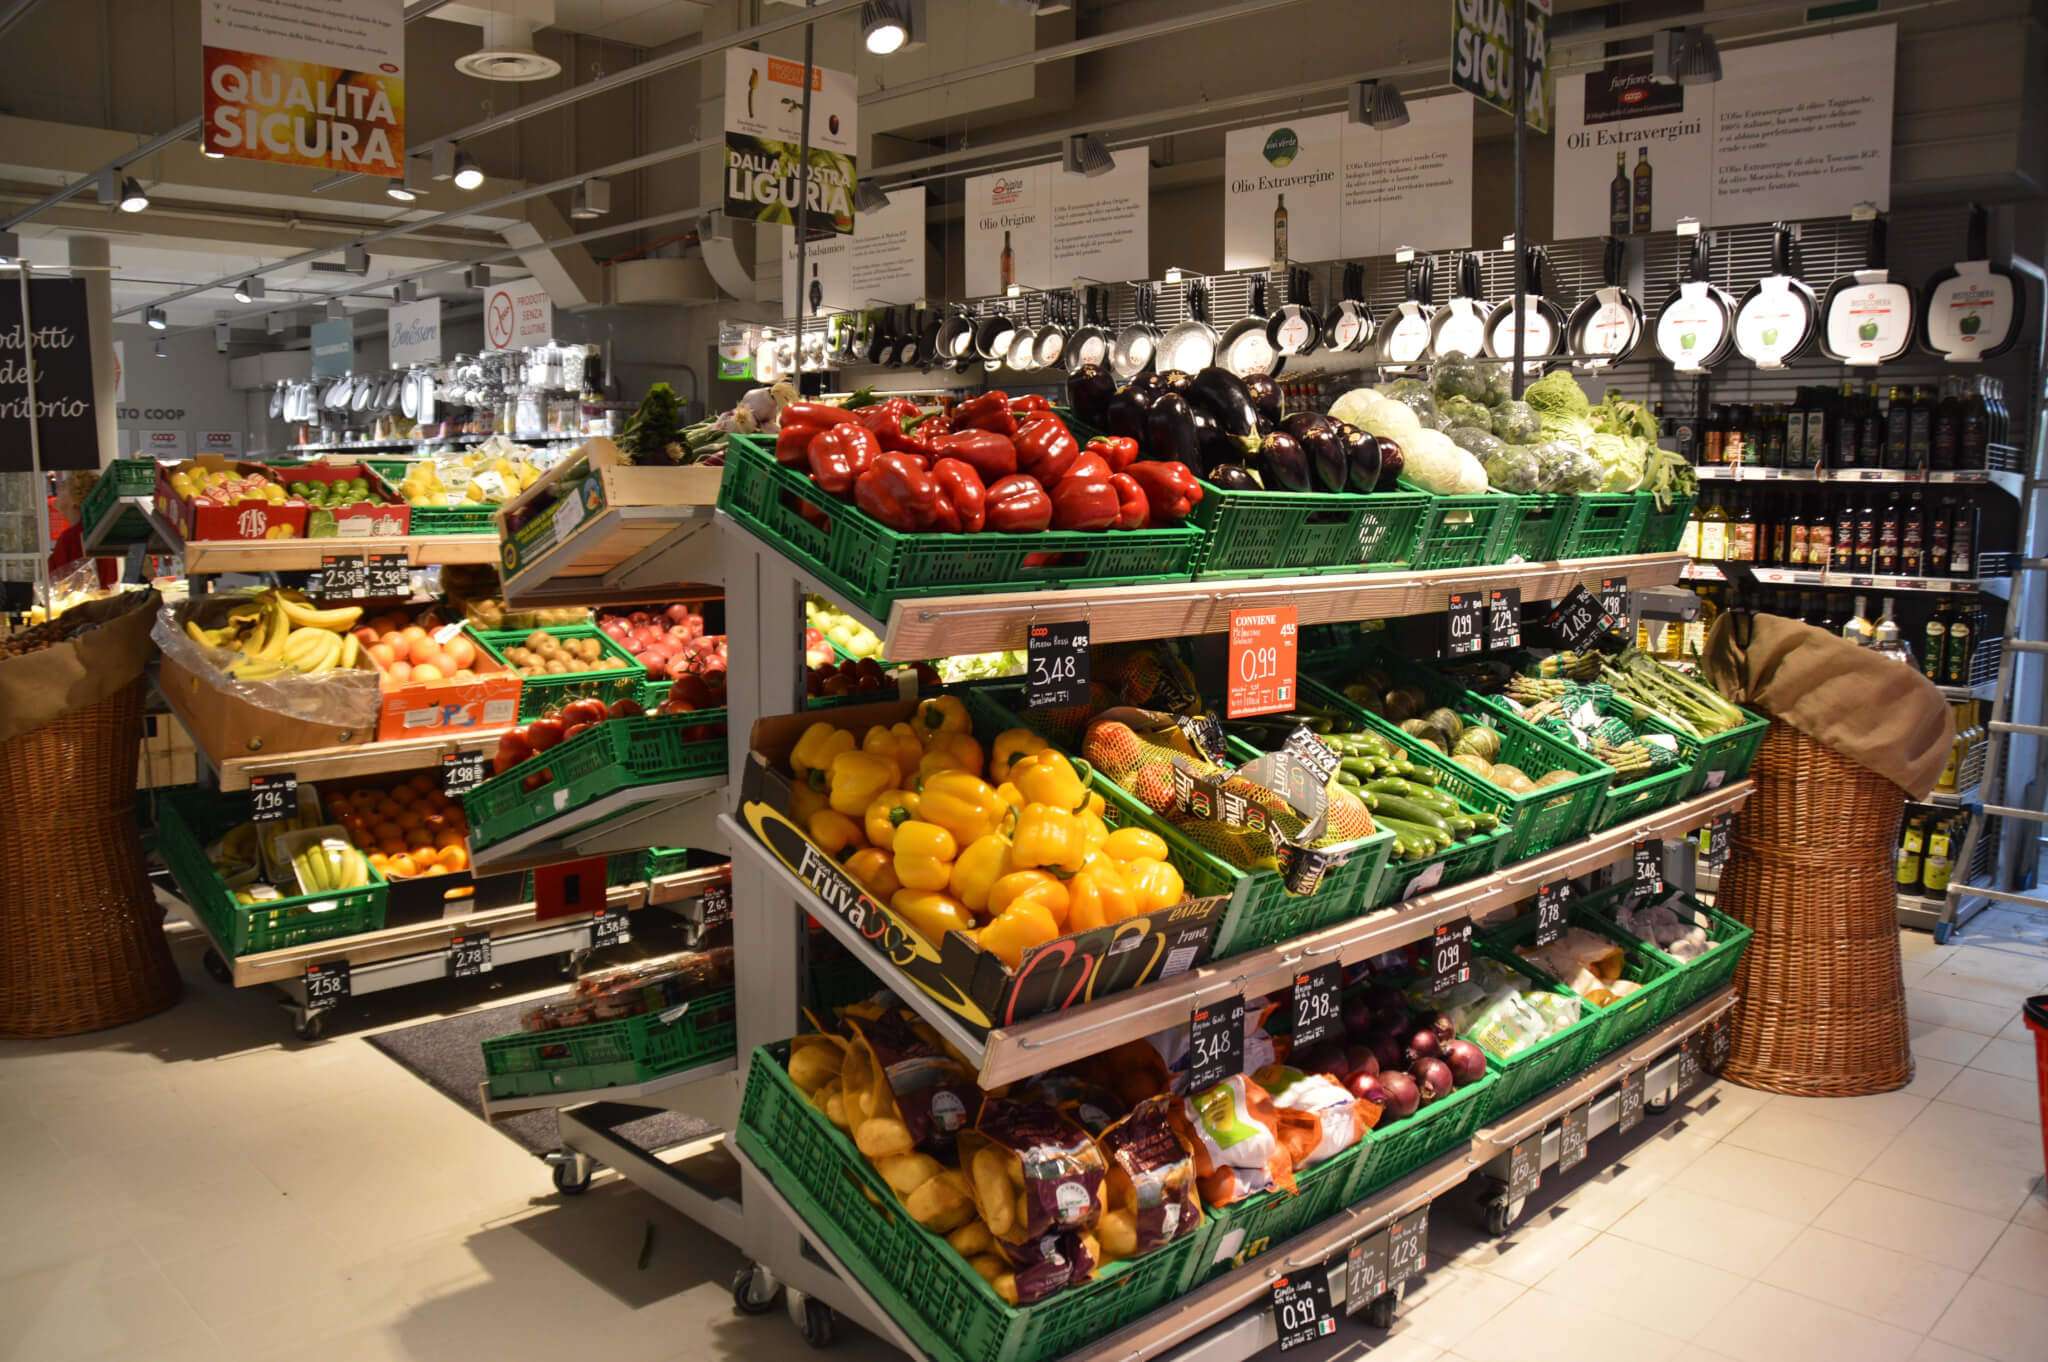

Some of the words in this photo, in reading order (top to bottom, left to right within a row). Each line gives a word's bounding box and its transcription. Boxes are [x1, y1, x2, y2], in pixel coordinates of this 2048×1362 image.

[211, 64, 396, 125] QUALITÀ
[214, 105, 397, 168] SICURA
[1567, 133, 1591, 150] Oli
[1596, 118, 1701, 146] Extravergini
[730, 151, 779, 175] DALLA
[729, 168, 851, 217] LIGURIA
[1232, 176, 1255, 194] Olio
[1258, 169, 1335, 191] Extravergine
[979, 216, 998, 231] Olio
[1000, 213, 1036, 229] Origine
[144, 408, 185, 420] COOP
[1235, 614, 1278, 626] CONVIENE
[1032, 655, 1076, 686] 3,48
[1241, 647, 1278, 683] 0,99
[798, 843, 866, 930] Fruva
[1298, 993, 1330, 1027] 2,98
[1192, 1030, 1231, 1069] 3,48
[1283, 1296, 1316, 1331] 0,99
